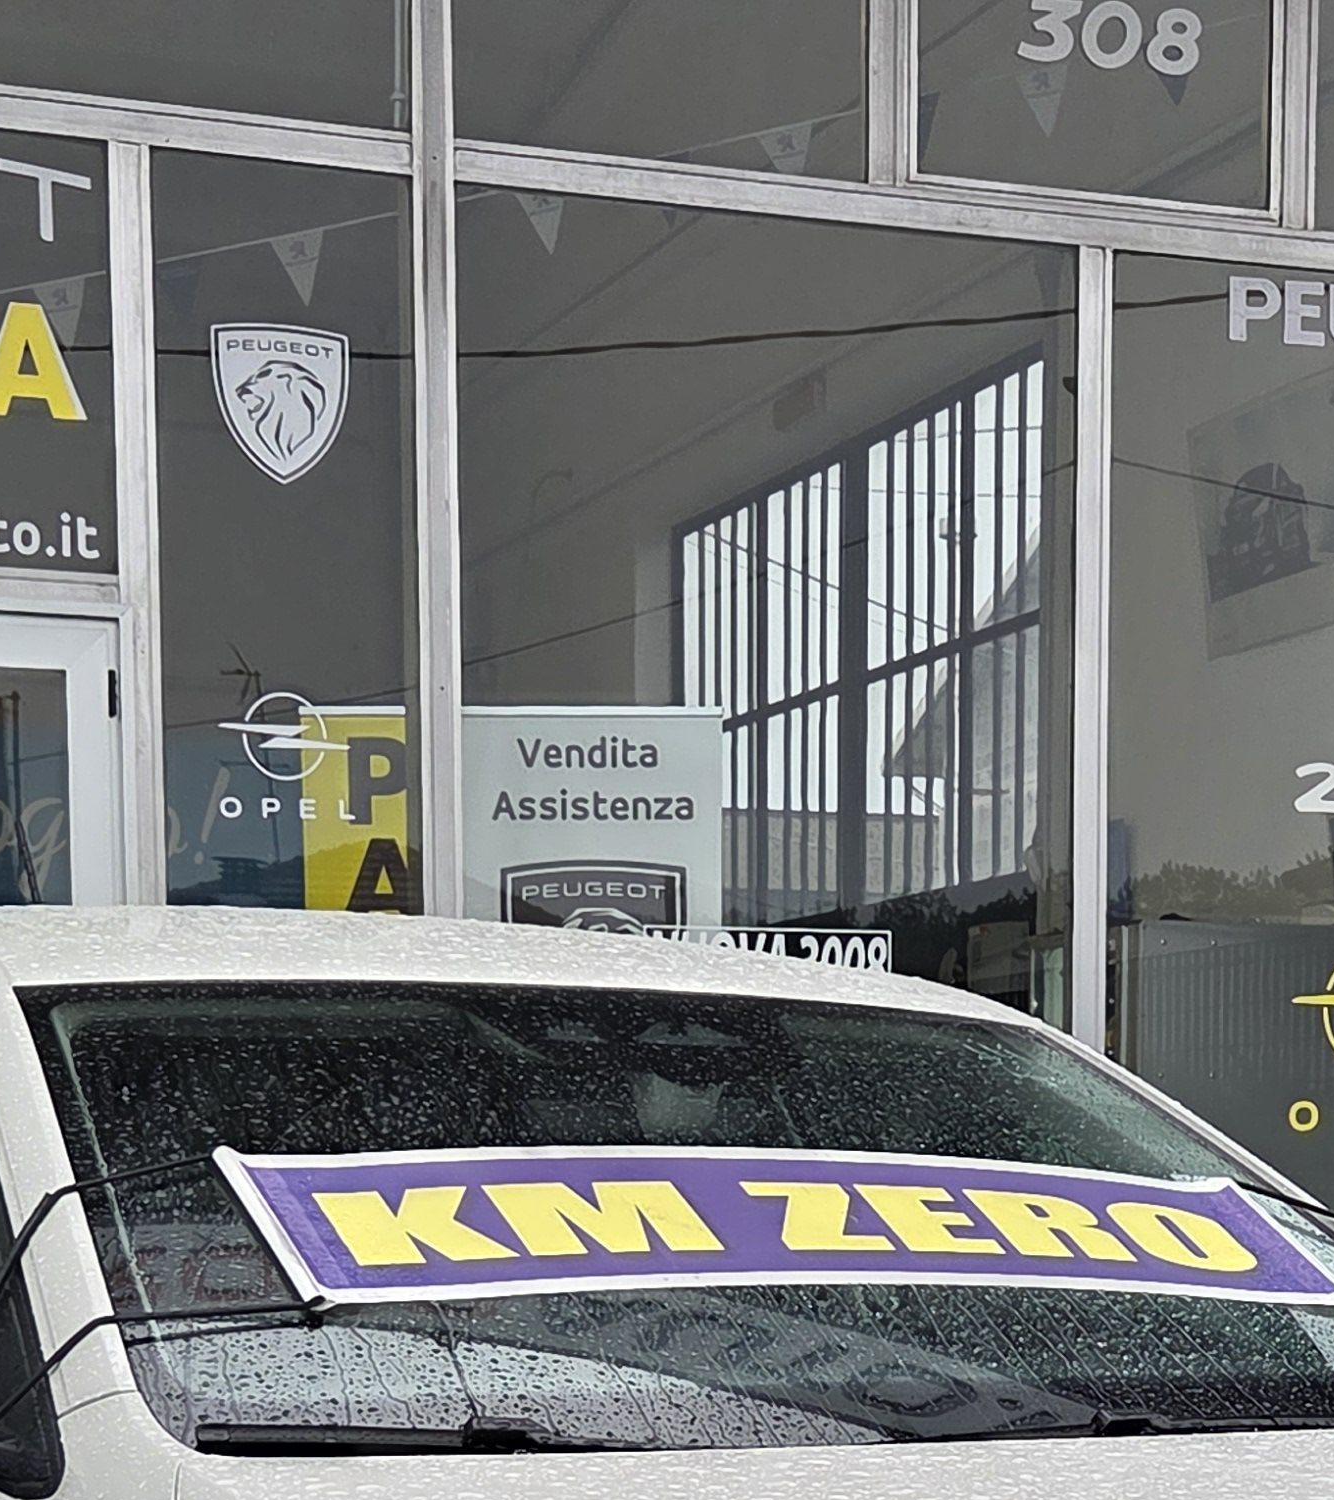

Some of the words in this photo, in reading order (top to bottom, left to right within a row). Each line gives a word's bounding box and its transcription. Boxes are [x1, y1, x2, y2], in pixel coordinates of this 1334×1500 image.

[1016, 0, 1202, 76] 308
[225, 338, 335, 360] PEUGEOT
[516, 736, 659, 769] Vendita
[219, 796, 356, 821] OPEL
[491, 788, 695, 822] Assistenza
[521, 881, 667, 901] PEUGEOT
[311, 1180, 726, 1267] KM
[739, 1180, 1259, 1273] ZERO
